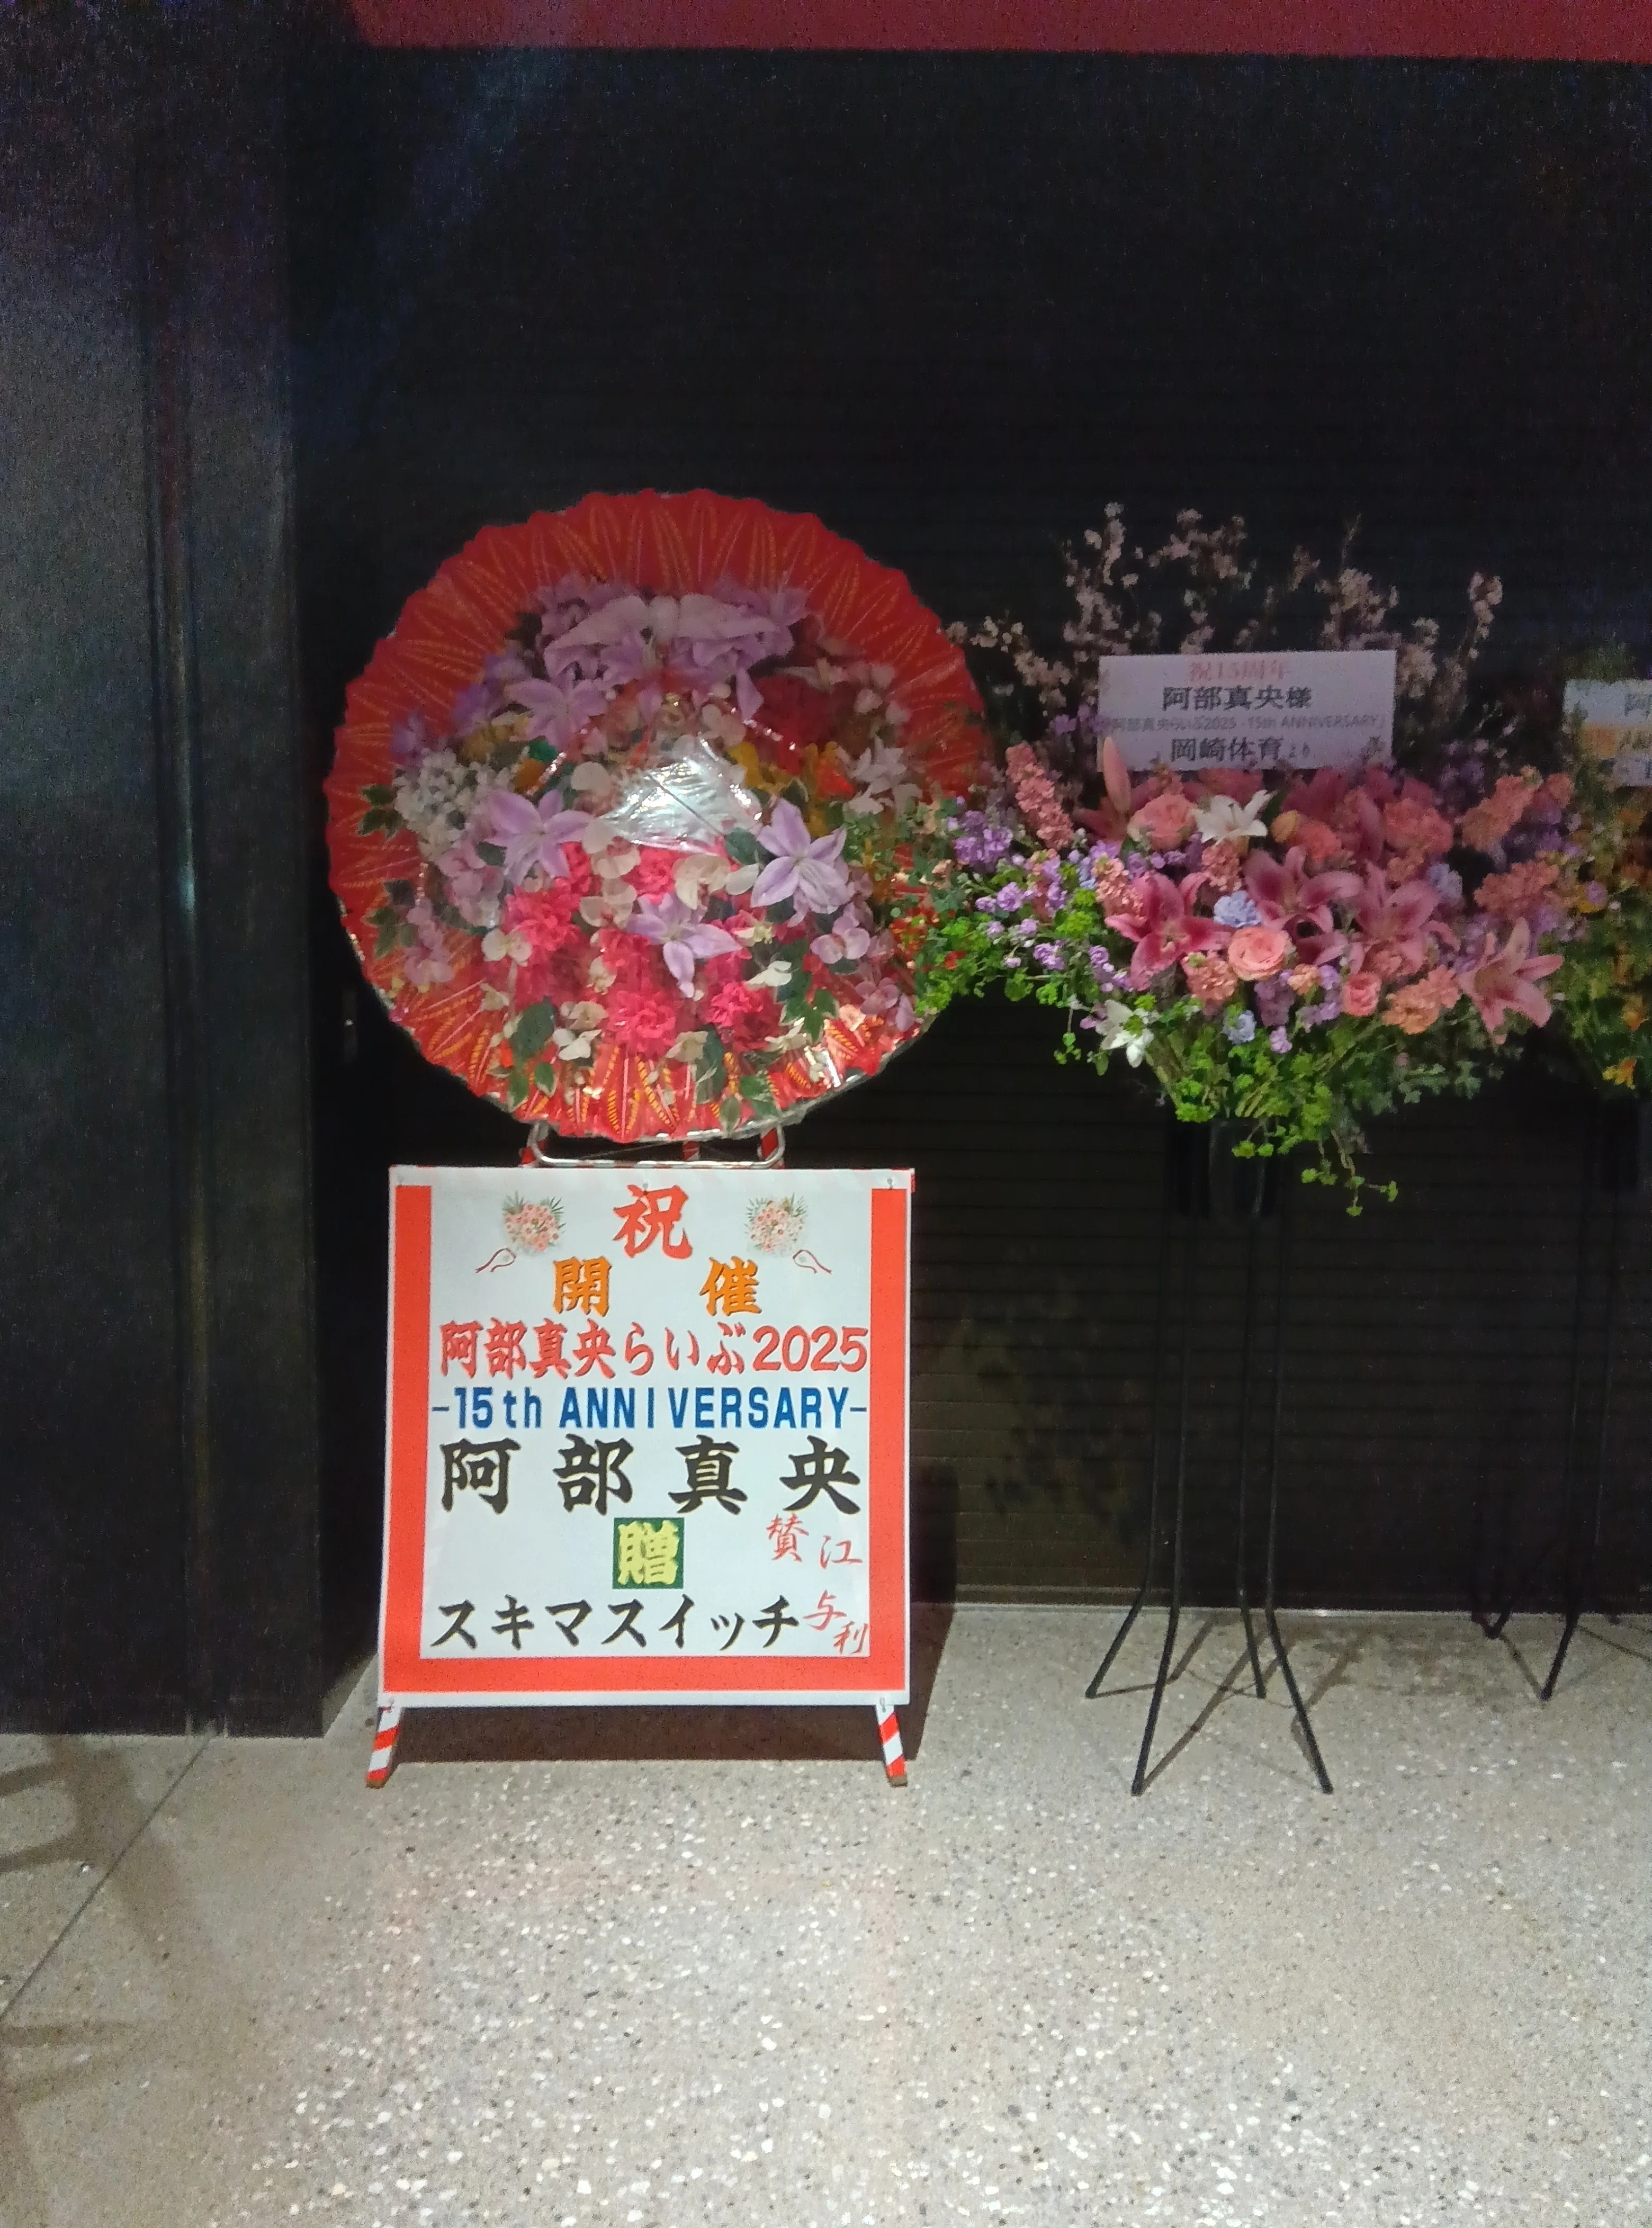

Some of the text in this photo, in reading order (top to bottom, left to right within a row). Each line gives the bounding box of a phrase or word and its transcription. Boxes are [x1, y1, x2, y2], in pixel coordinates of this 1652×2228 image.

[1162, 685, 1313, 712] 阿部真央様
[613, 1184, 693, 1259] 祝
[553, 1256, 762, 1317] 開催
[439, 1318, 868, 1379] 阿部真央らいぶ2025
[439, 1434, 860, 1515] 阿部真央
[617, 1521, 678, 1586] 贈
[430, 1595, 799, 1651] スキマスイッチ
